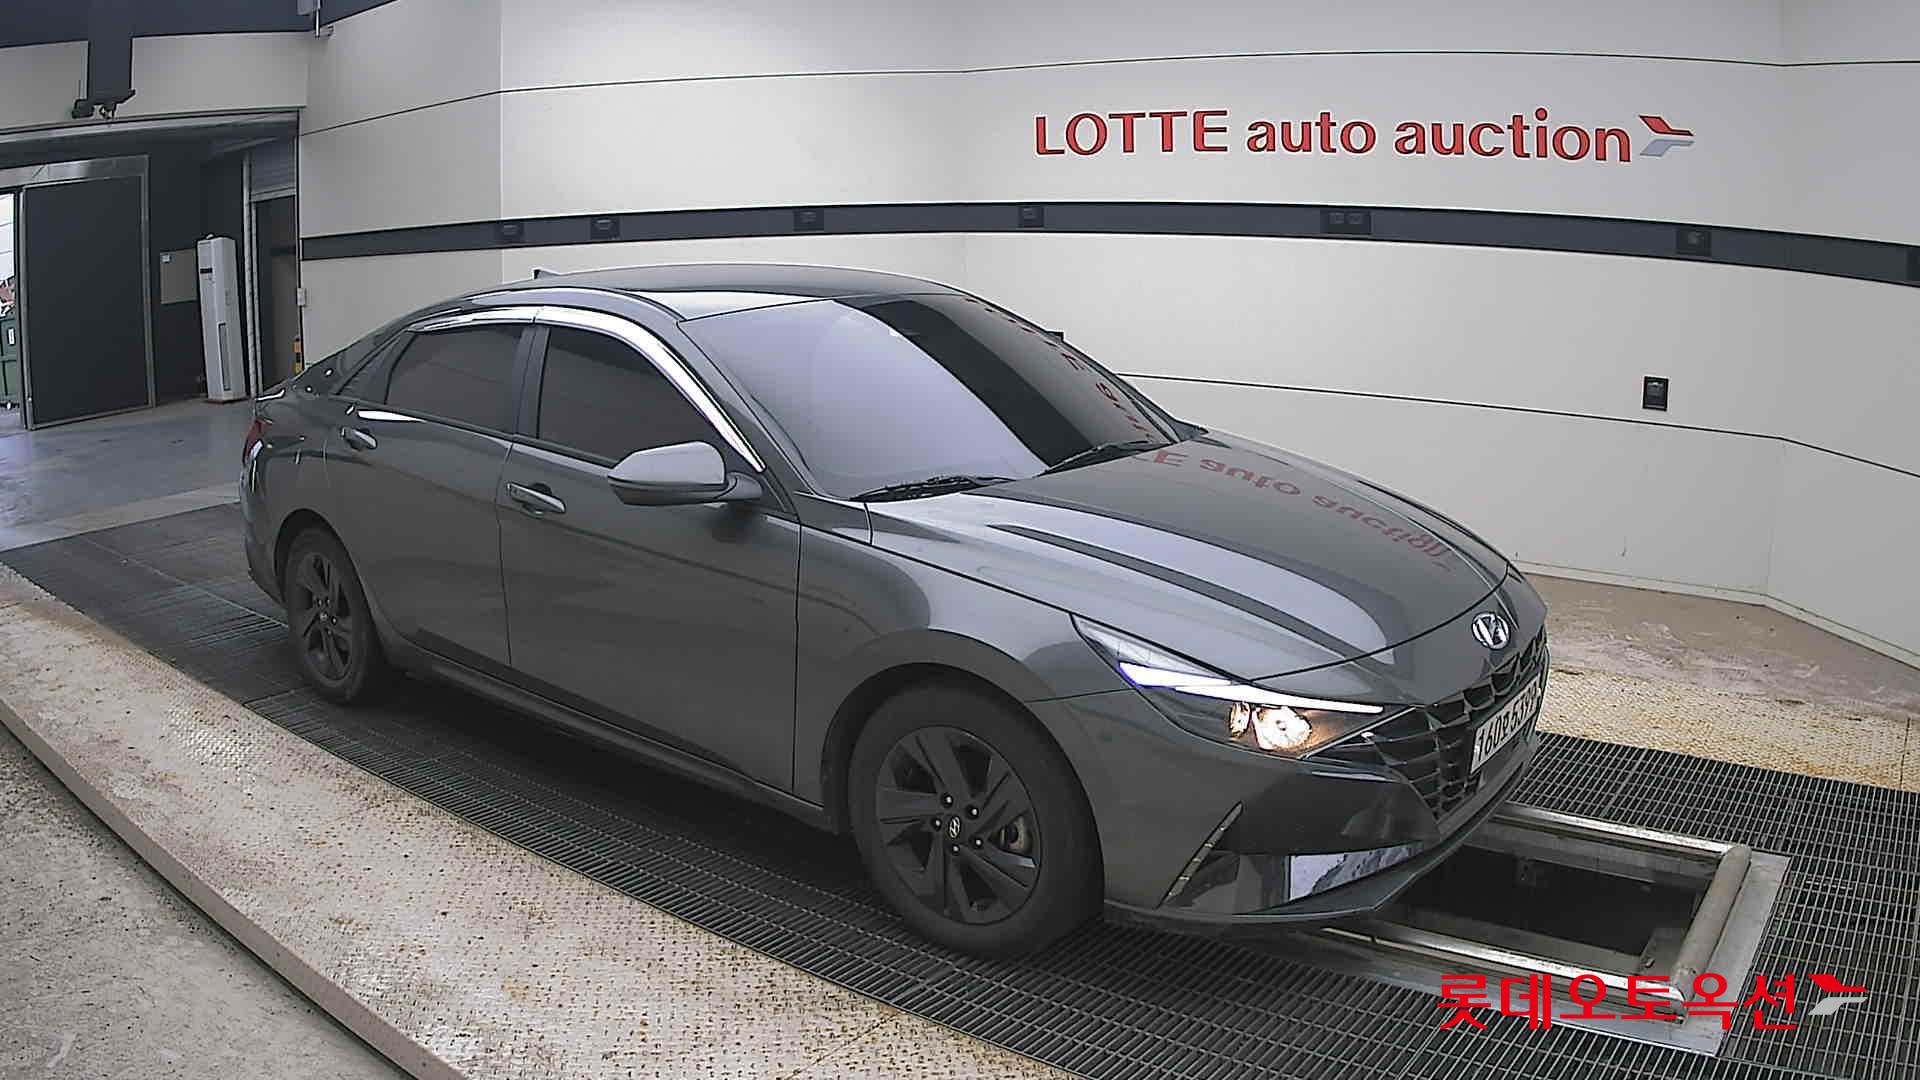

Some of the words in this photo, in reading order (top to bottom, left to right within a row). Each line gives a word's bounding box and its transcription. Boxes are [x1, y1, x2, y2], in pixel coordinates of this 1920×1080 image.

[1035, 110, 1228, 156] LOTTE
[1246, 111, 1376, 155] auto
[1394, 107, 1633, 163] auction
